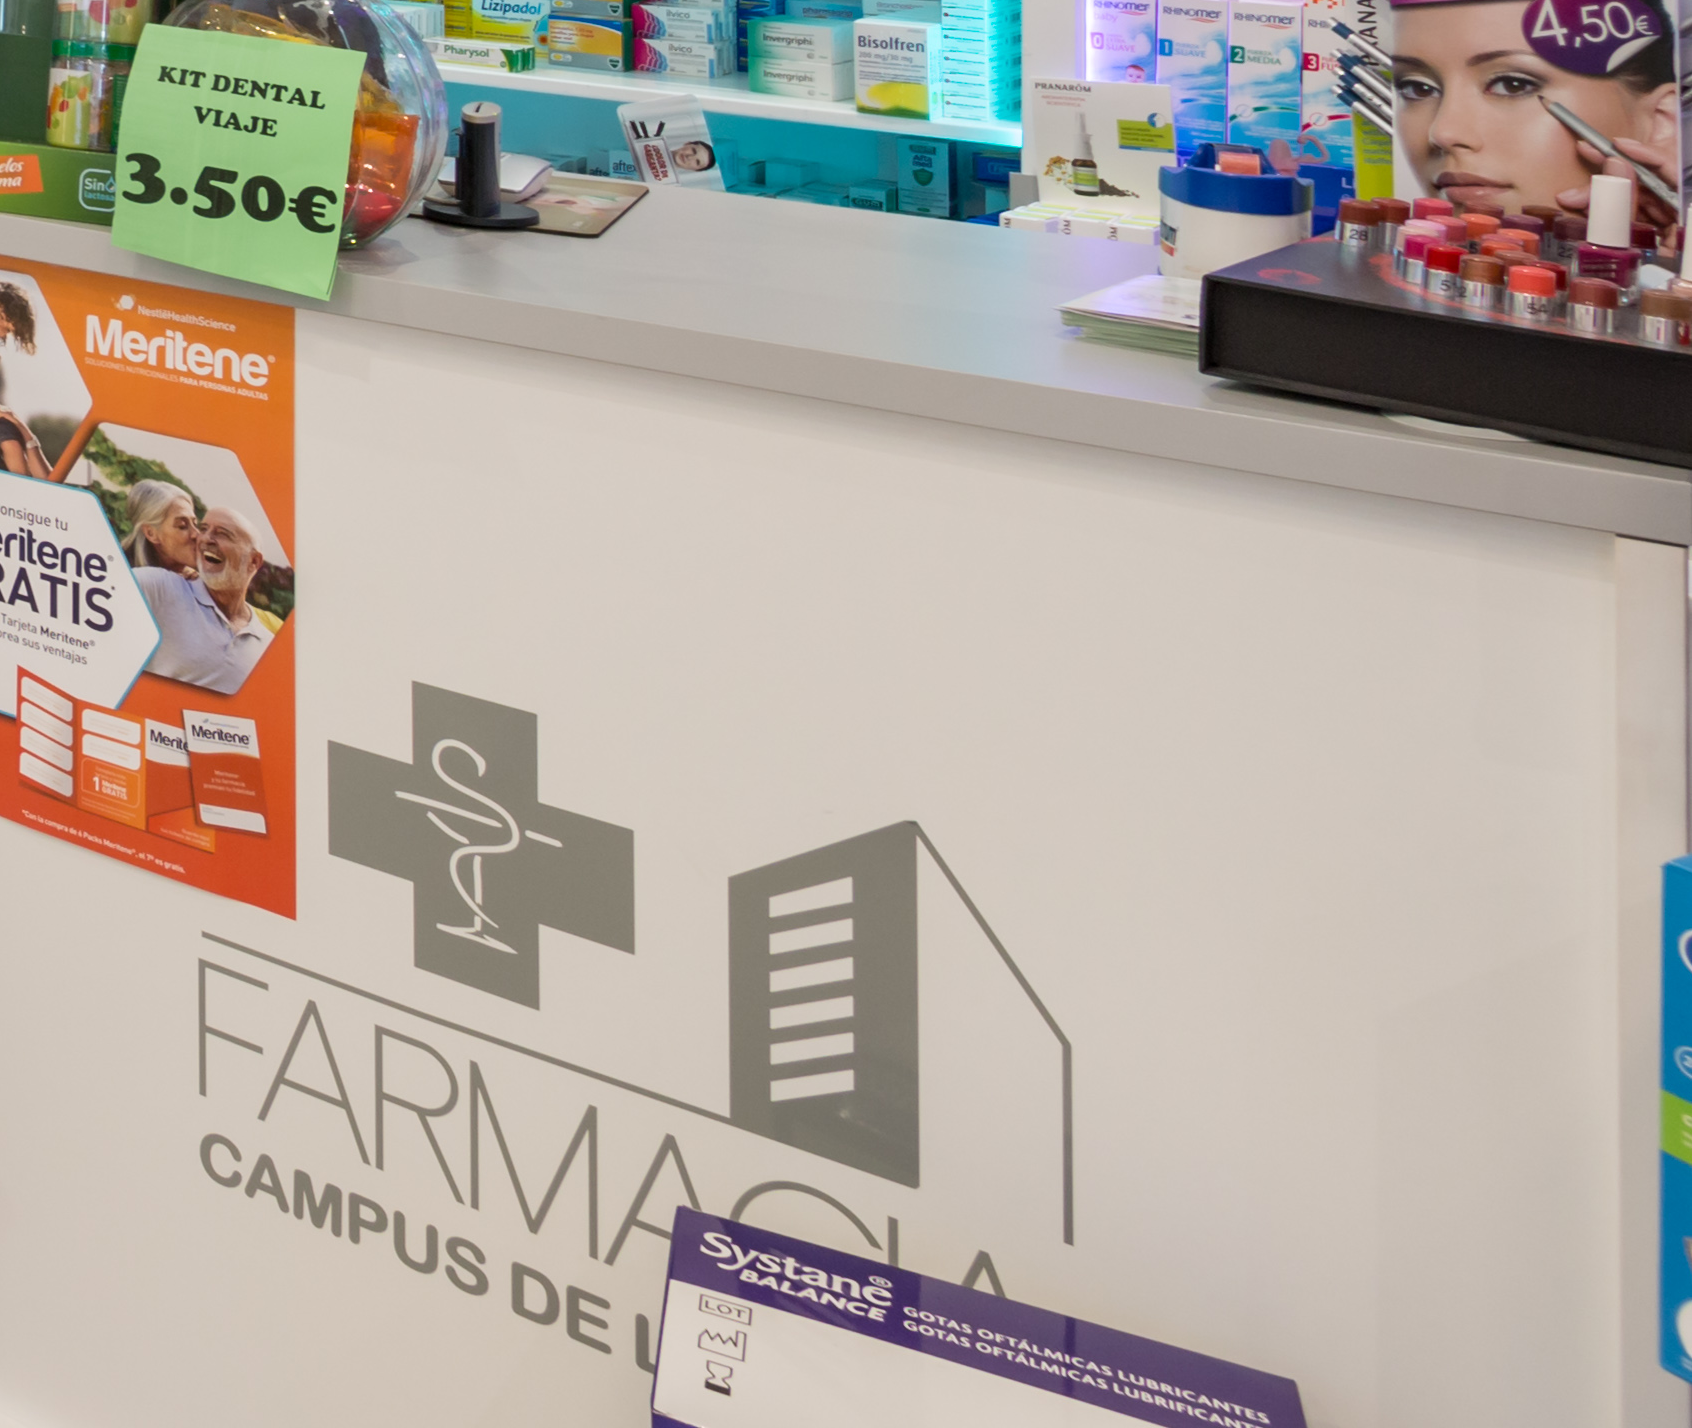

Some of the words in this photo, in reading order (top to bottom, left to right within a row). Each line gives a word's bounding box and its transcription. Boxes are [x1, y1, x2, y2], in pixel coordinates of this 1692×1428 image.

[444, 44, 490, 56] Pharysol
[858, 36, 925, 53] Bisolfren
[158, 65, 202, 87] KIT
[211, 71, 325, 111] DENTAL
[194, 105, 278, 138] VIAJE
[123, 150, 336, 234] 3.50€
[54, 516, 68, 530] tu
[0, 614, 37, 636] Tarjeta
[199, 1133, 488, 1296] CAMPUS
[510, 1262, 614, 1357] DE
[709, 1301, 746, 1319] LOT
[739, 1269, 887, 1322] BALANCE
[903, 1306, 972, 1335] GOTAS
[976, 1327, 1113, 1376] OFTÁLMICAS
[1117, 1369, 1270, 1425] LUBRICANTES
